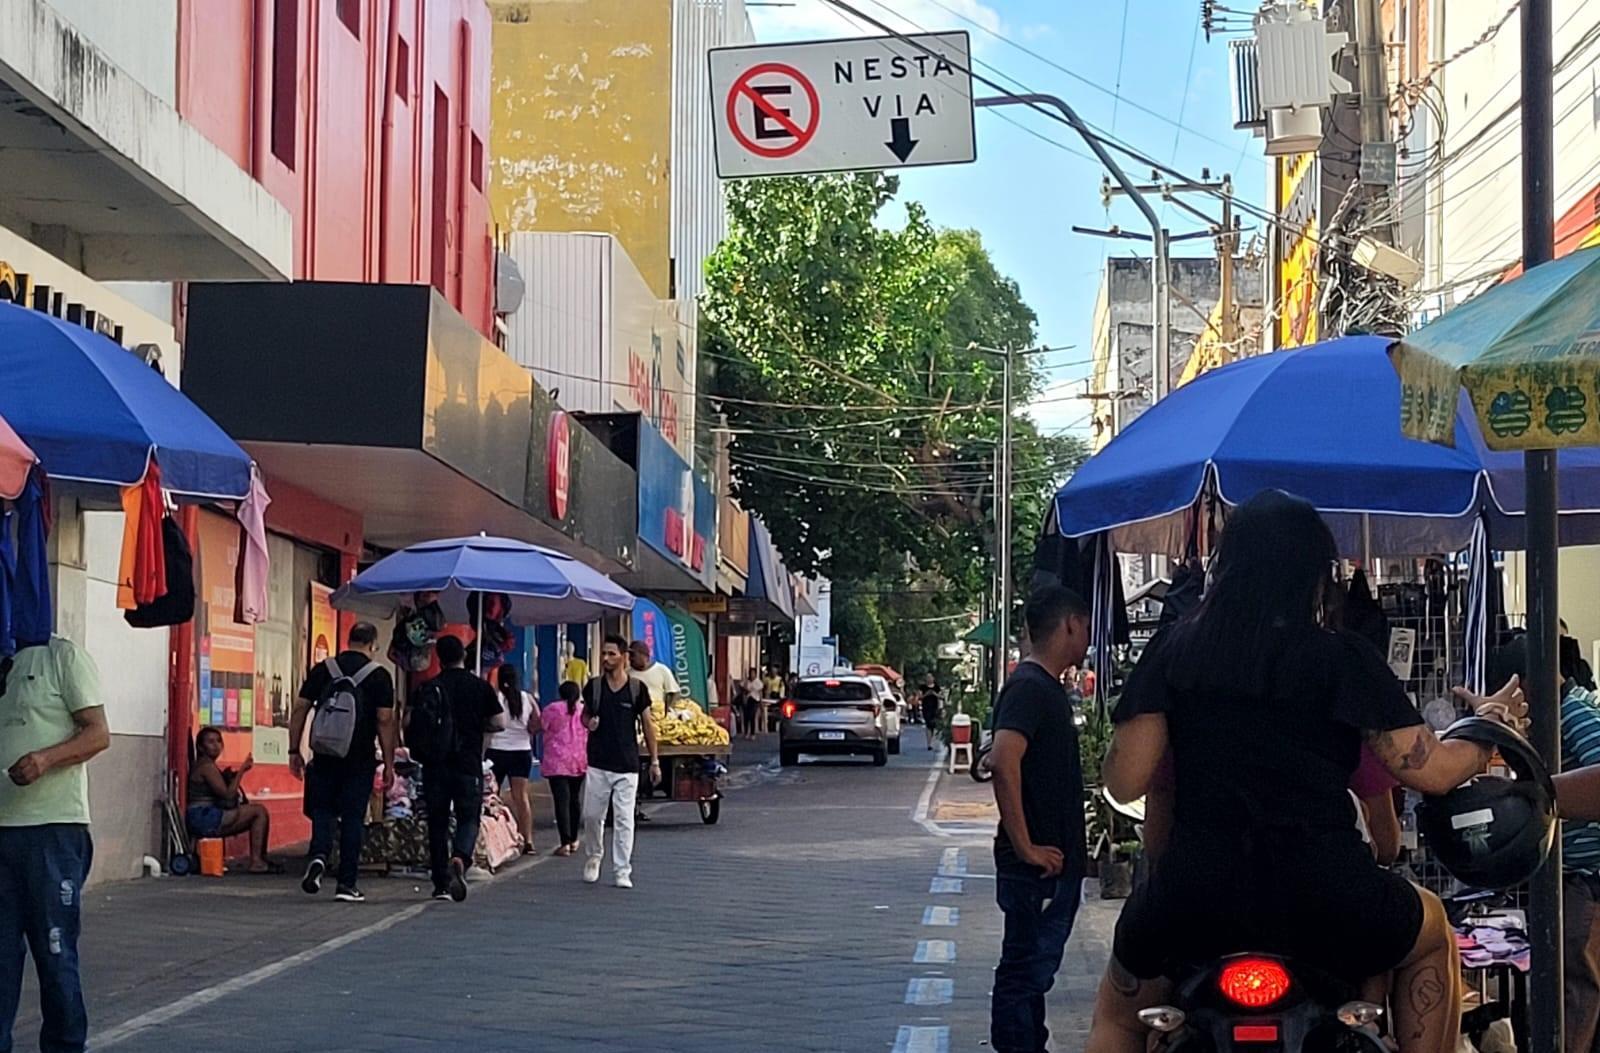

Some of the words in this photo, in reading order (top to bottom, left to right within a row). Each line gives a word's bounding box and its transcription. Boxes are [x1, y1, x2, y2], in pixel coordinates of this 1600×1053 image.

[834, 54, 954, 84] NESTA
[863, 93, 936, 118] VIA
[672, 623, 691, 698] OTICARIO
